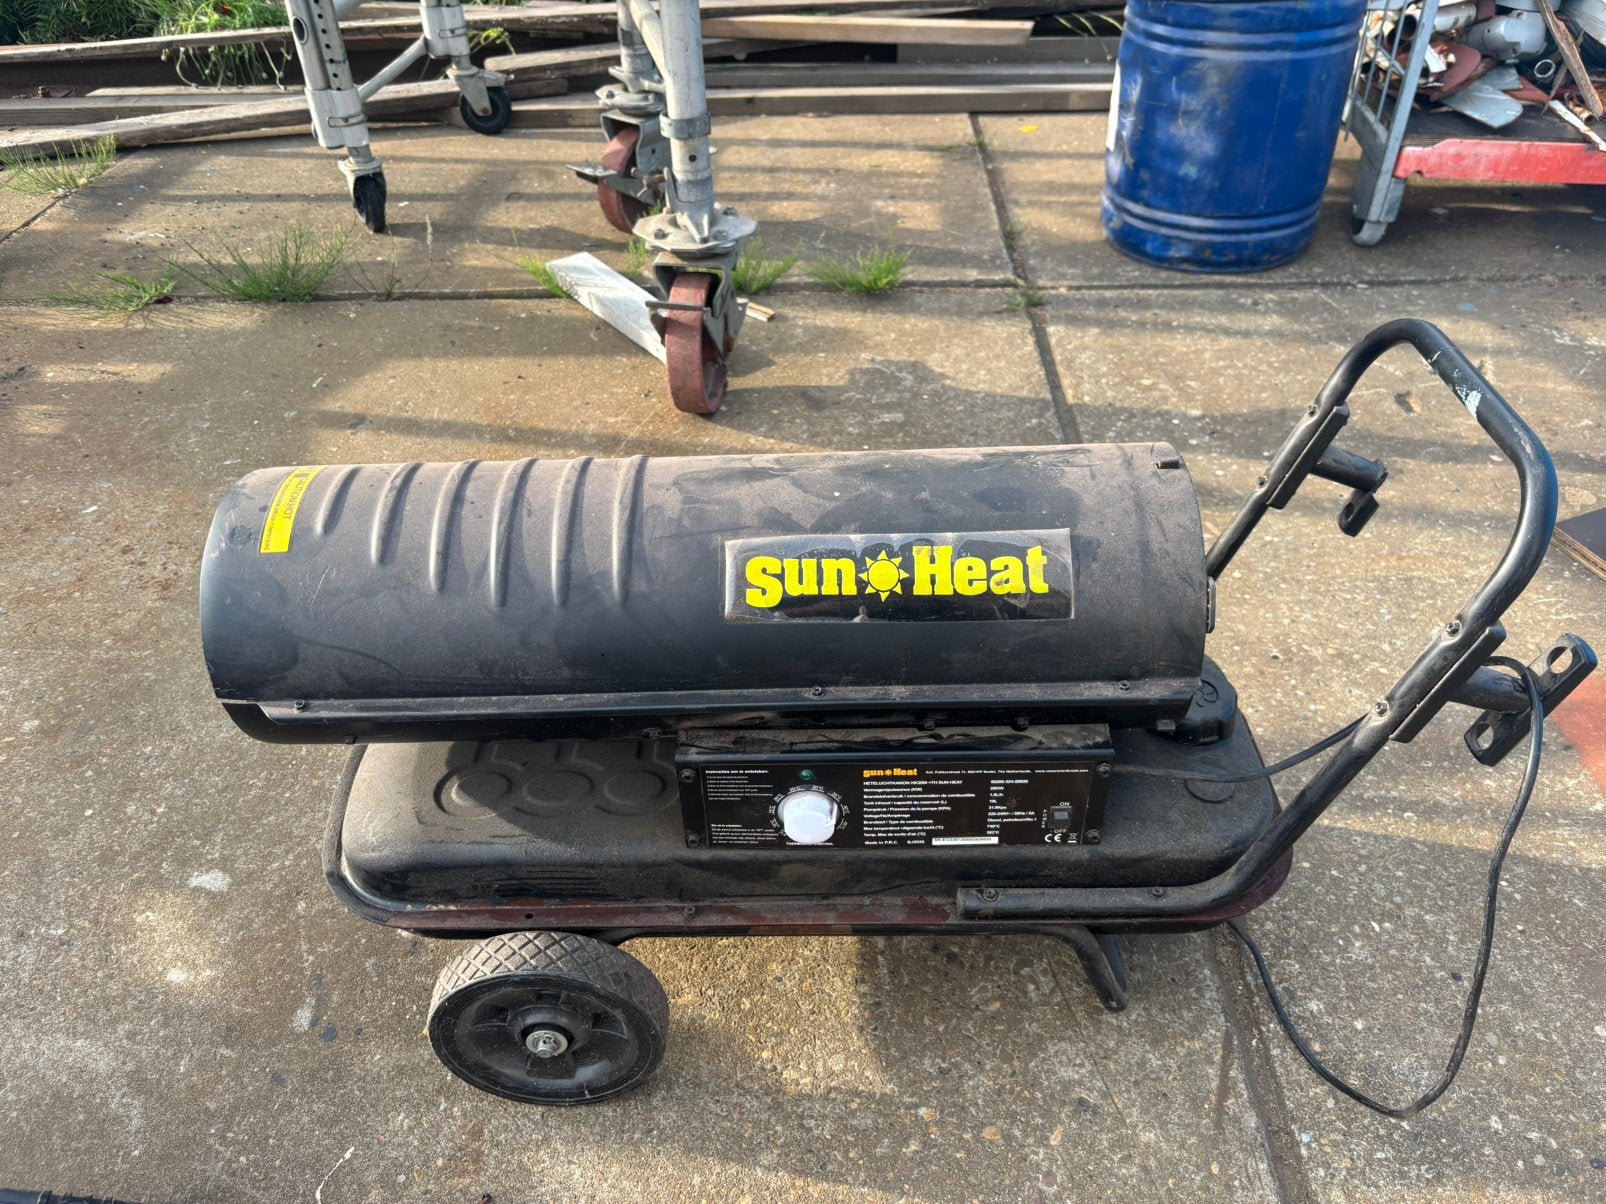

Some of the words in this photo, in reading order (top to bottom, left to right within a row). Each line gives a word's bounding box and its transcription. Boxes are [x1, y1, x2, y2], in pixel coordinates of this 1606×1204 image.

[745, 556, 857, 608] Sun
[912, 545, 1049, 595] Heat
[893, 768, 918, 776] Heat
